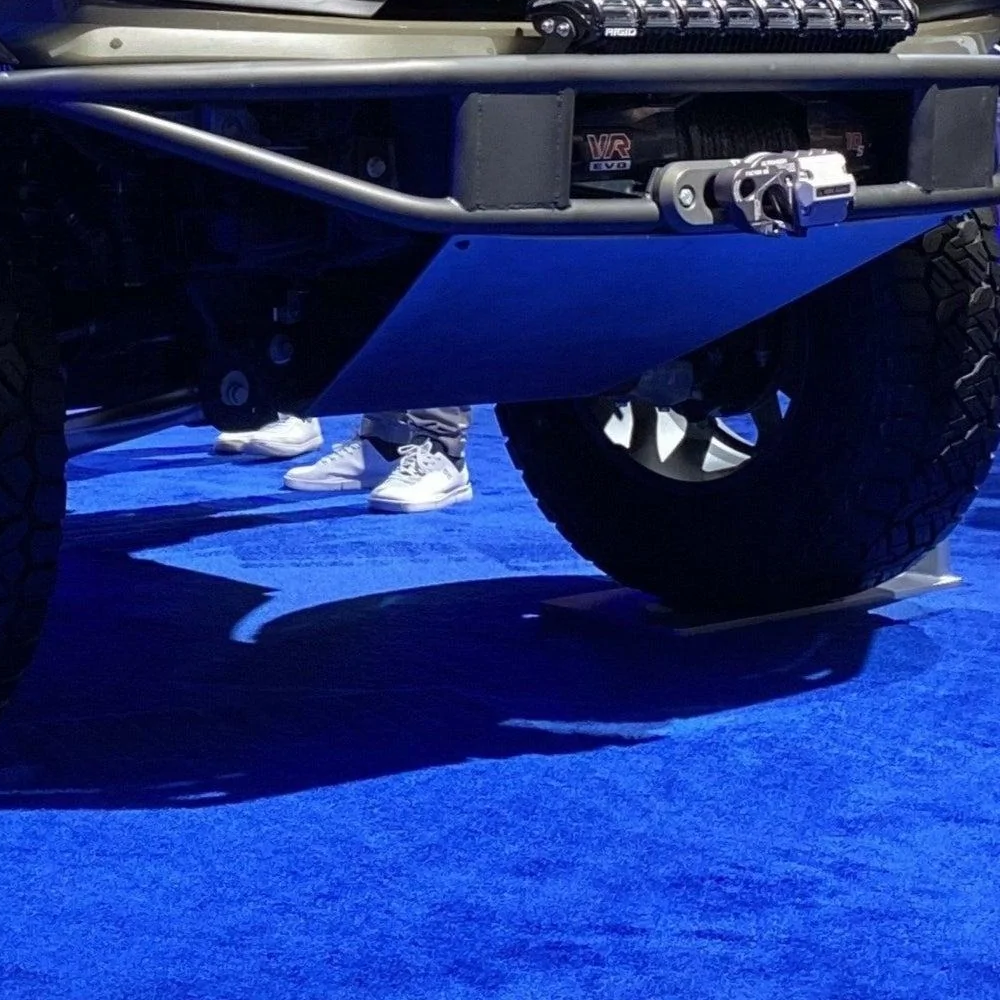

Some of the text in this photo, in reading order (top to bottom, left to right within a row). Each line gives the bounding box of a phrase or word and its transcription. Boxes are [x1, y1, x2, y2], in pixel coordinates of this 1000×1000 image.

[604, 27, 637, 37] RIGID
[586, 132, 632, 160] VR
[592, 162, 628, 171] EVO
